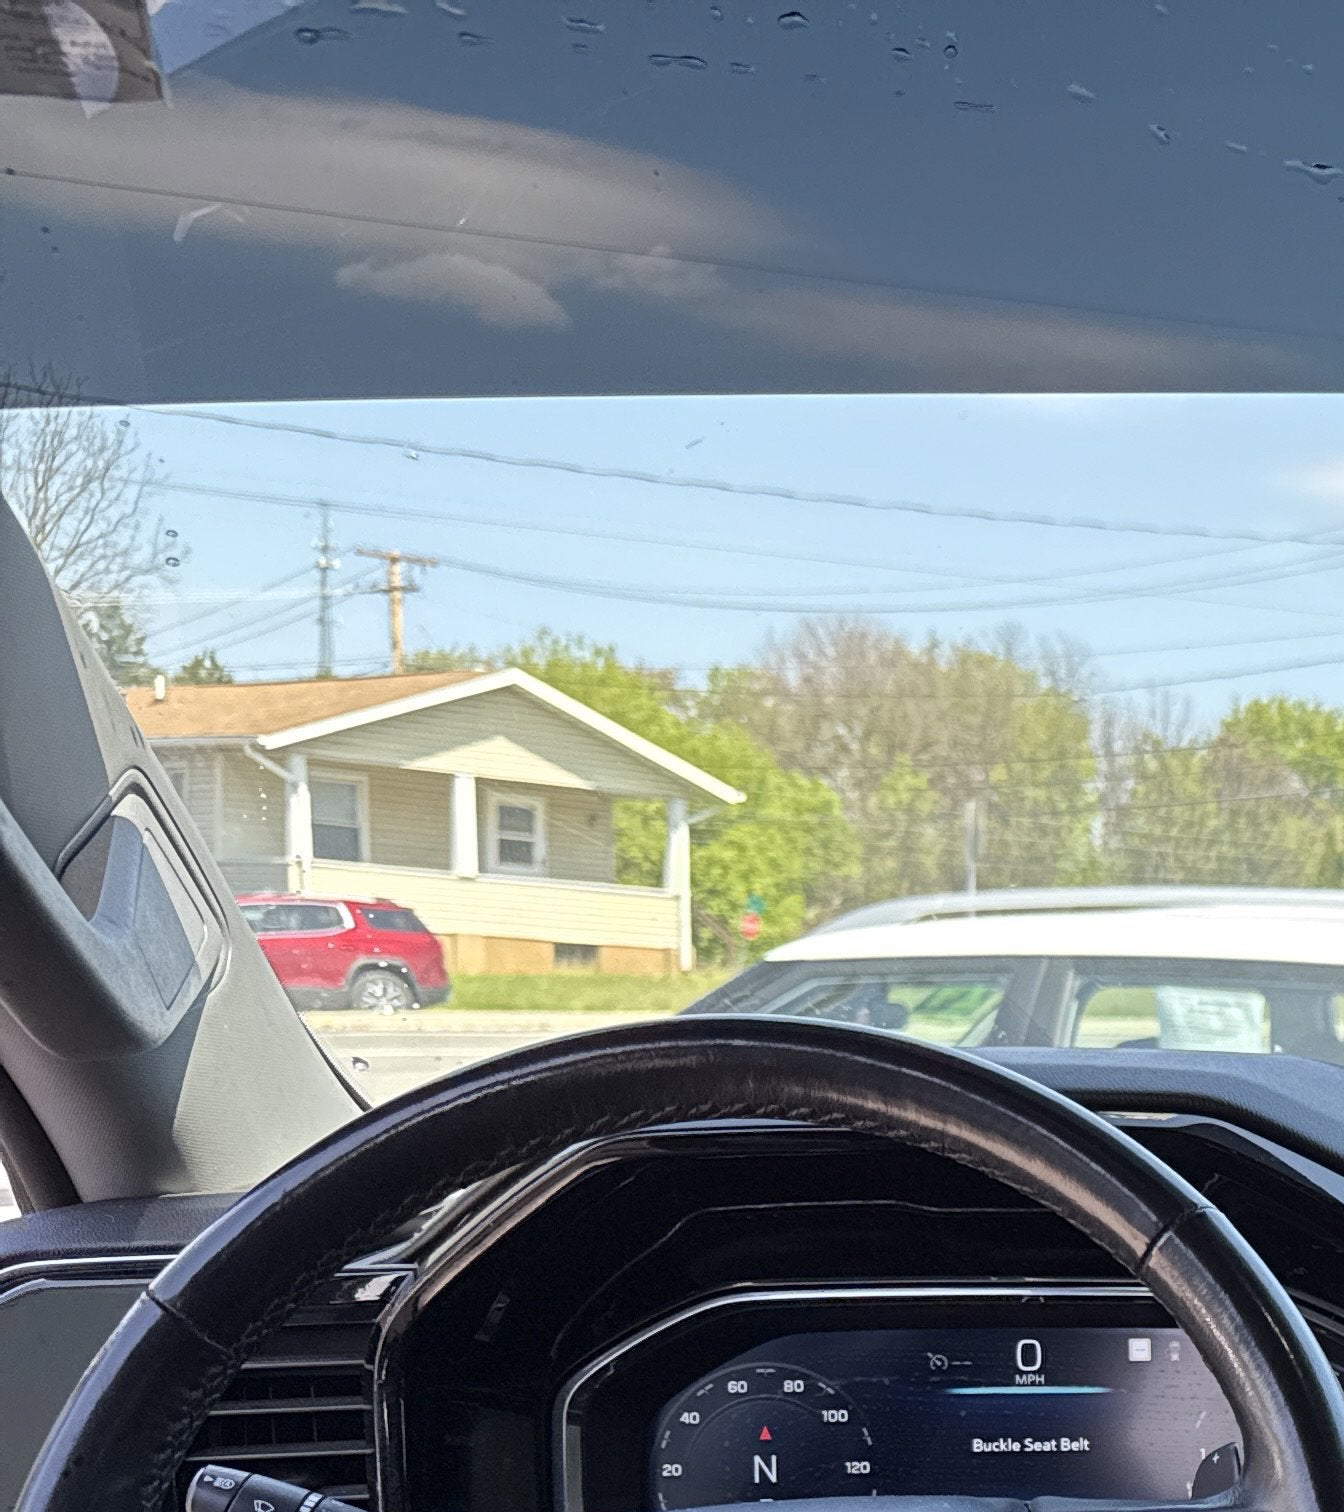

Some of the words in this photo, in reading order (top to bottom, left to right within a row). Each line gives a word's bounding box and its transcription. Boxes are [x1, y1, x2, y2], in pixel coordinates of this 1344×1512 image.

[1016, 1338, 1042, 1372] 0
[727, 1380, 748, 1394] 60
[783, 1379, 805, 1393] 80
[1015, 1374, 1045, 1386] MPH
[679, 1411, 700, 1425] 40
[821, 1409, 849, 1423] 100
[972, 1437, 1022, 1453] Buckle
[1024, 1437, 1058, 1452] Seat
[1060, 1436, 1091, 1452] Belt
[661, 1463, 683, 1477] 20
[753, 1454, 777, 1484] N
[844, 1461, 871, 1475] 120
